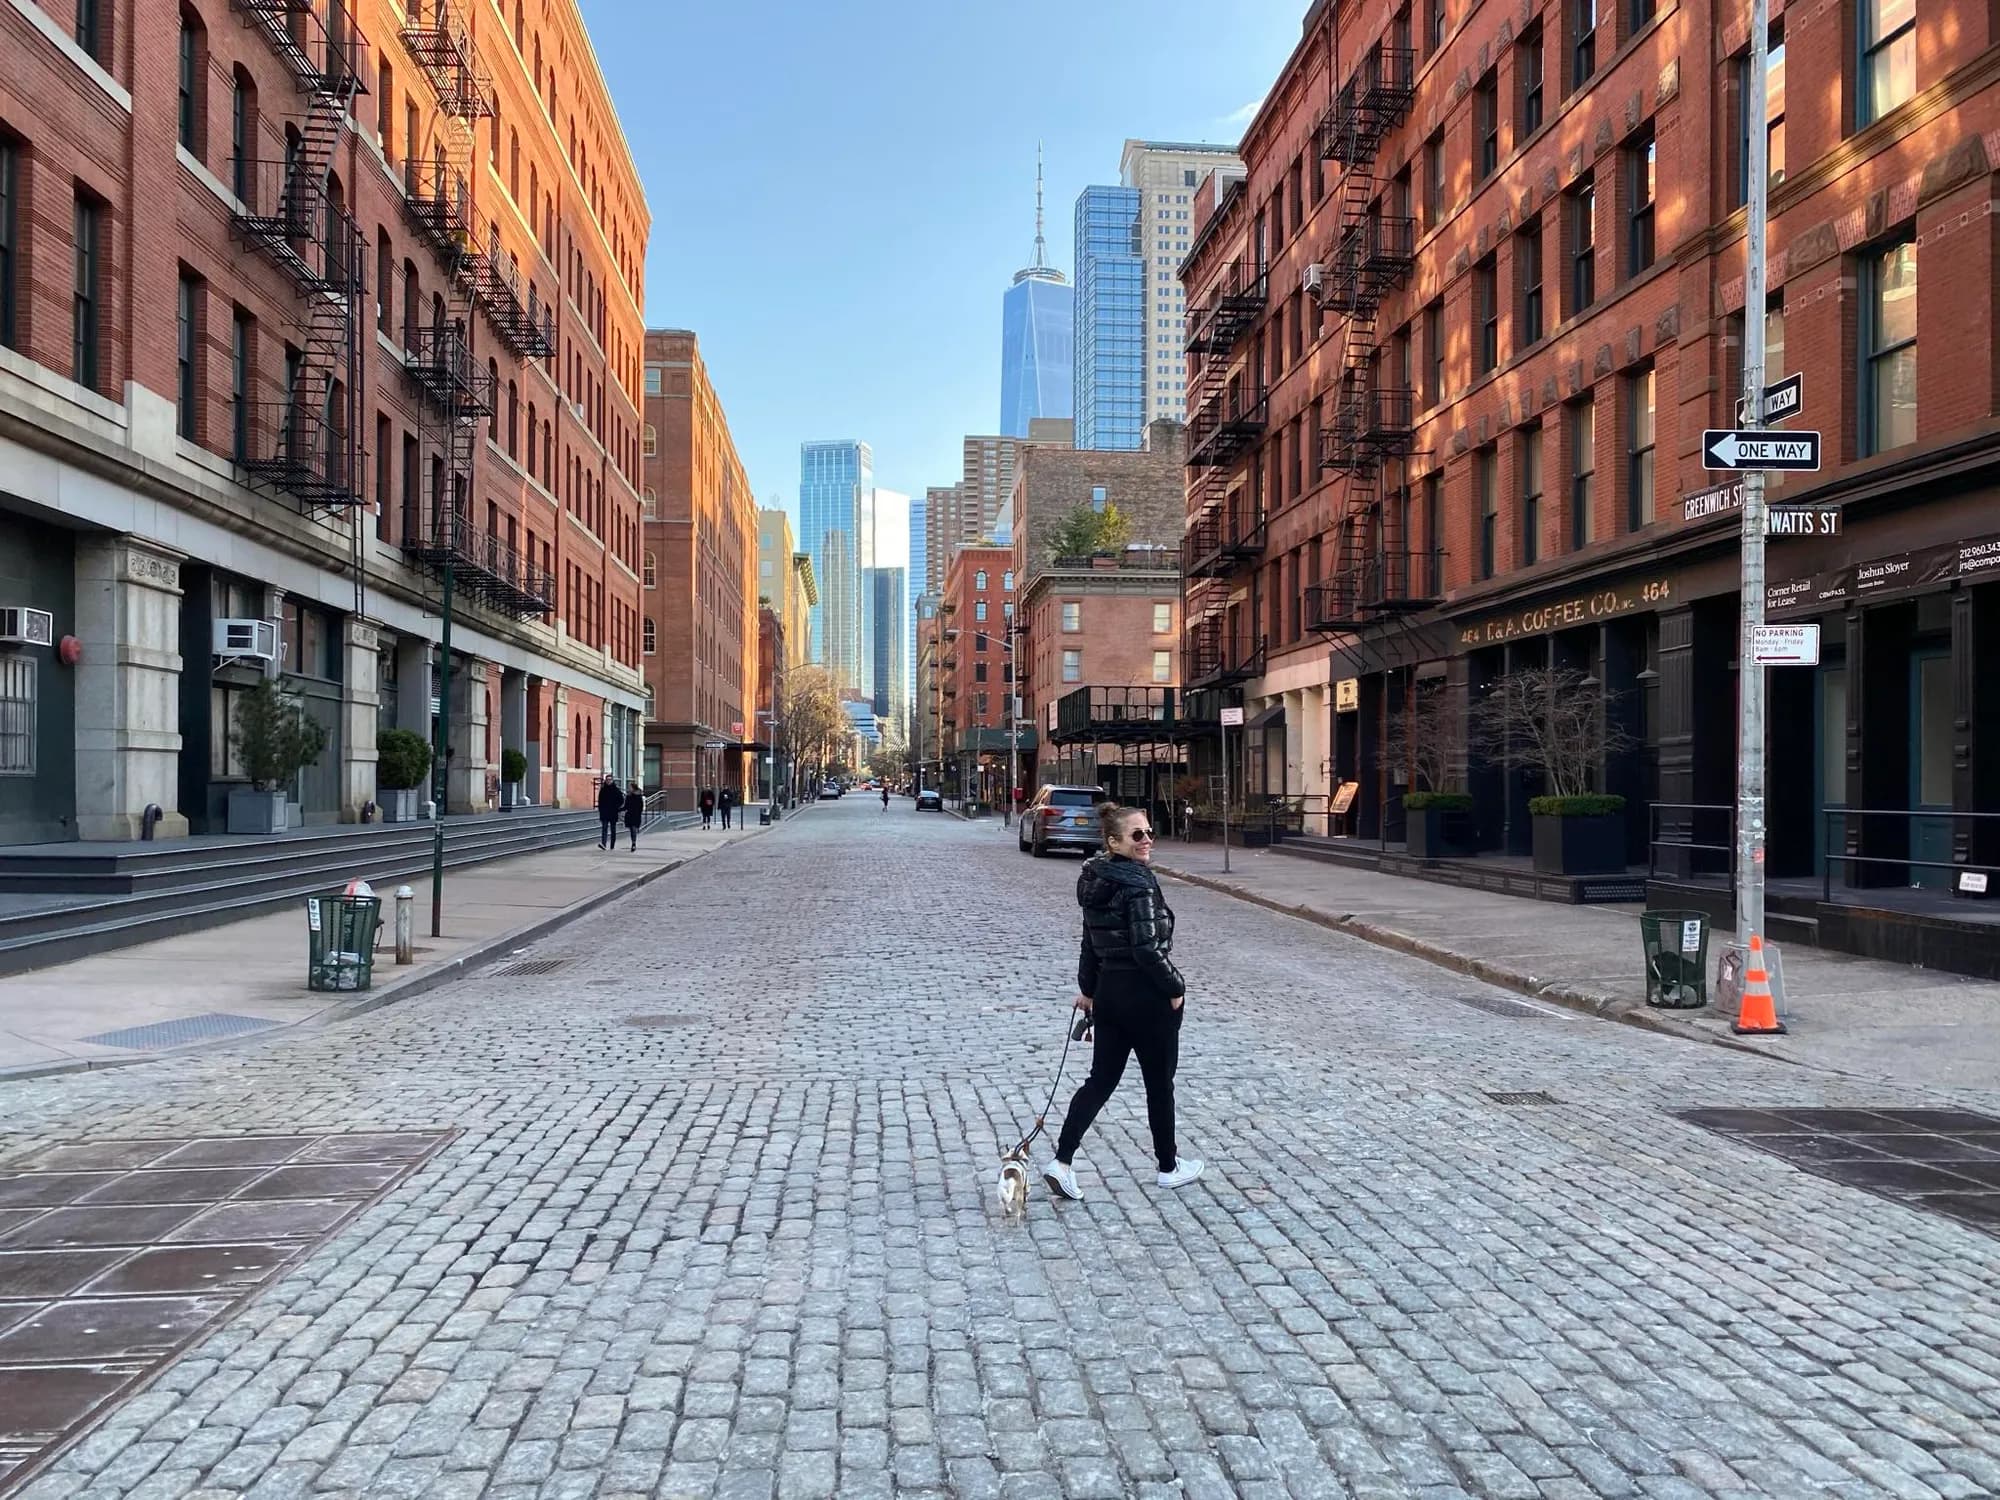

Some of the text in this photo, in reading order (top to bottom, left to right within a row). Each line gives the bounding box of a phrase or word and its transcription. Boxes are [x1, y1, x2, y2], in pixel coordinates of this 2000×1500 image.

[1771, 389, 1793, 411] WAY
[1738, 443, 1807, 458] ONE WAY
[1685, 490, 1730, 521] GREENWICH
[1770, 512, 1837, 534] WATTS ST
[1857, 567, 1885, 580] Joshua
[1767, 580, 1811, 598] Corner Retail
[1818, 588, 1846, 599] COMPASS
[1767, 596, 1797, 609] for Lease
[1522, 600, 1585, 632] COFFEE
[1769, 629, 1803, 637] PARKING
